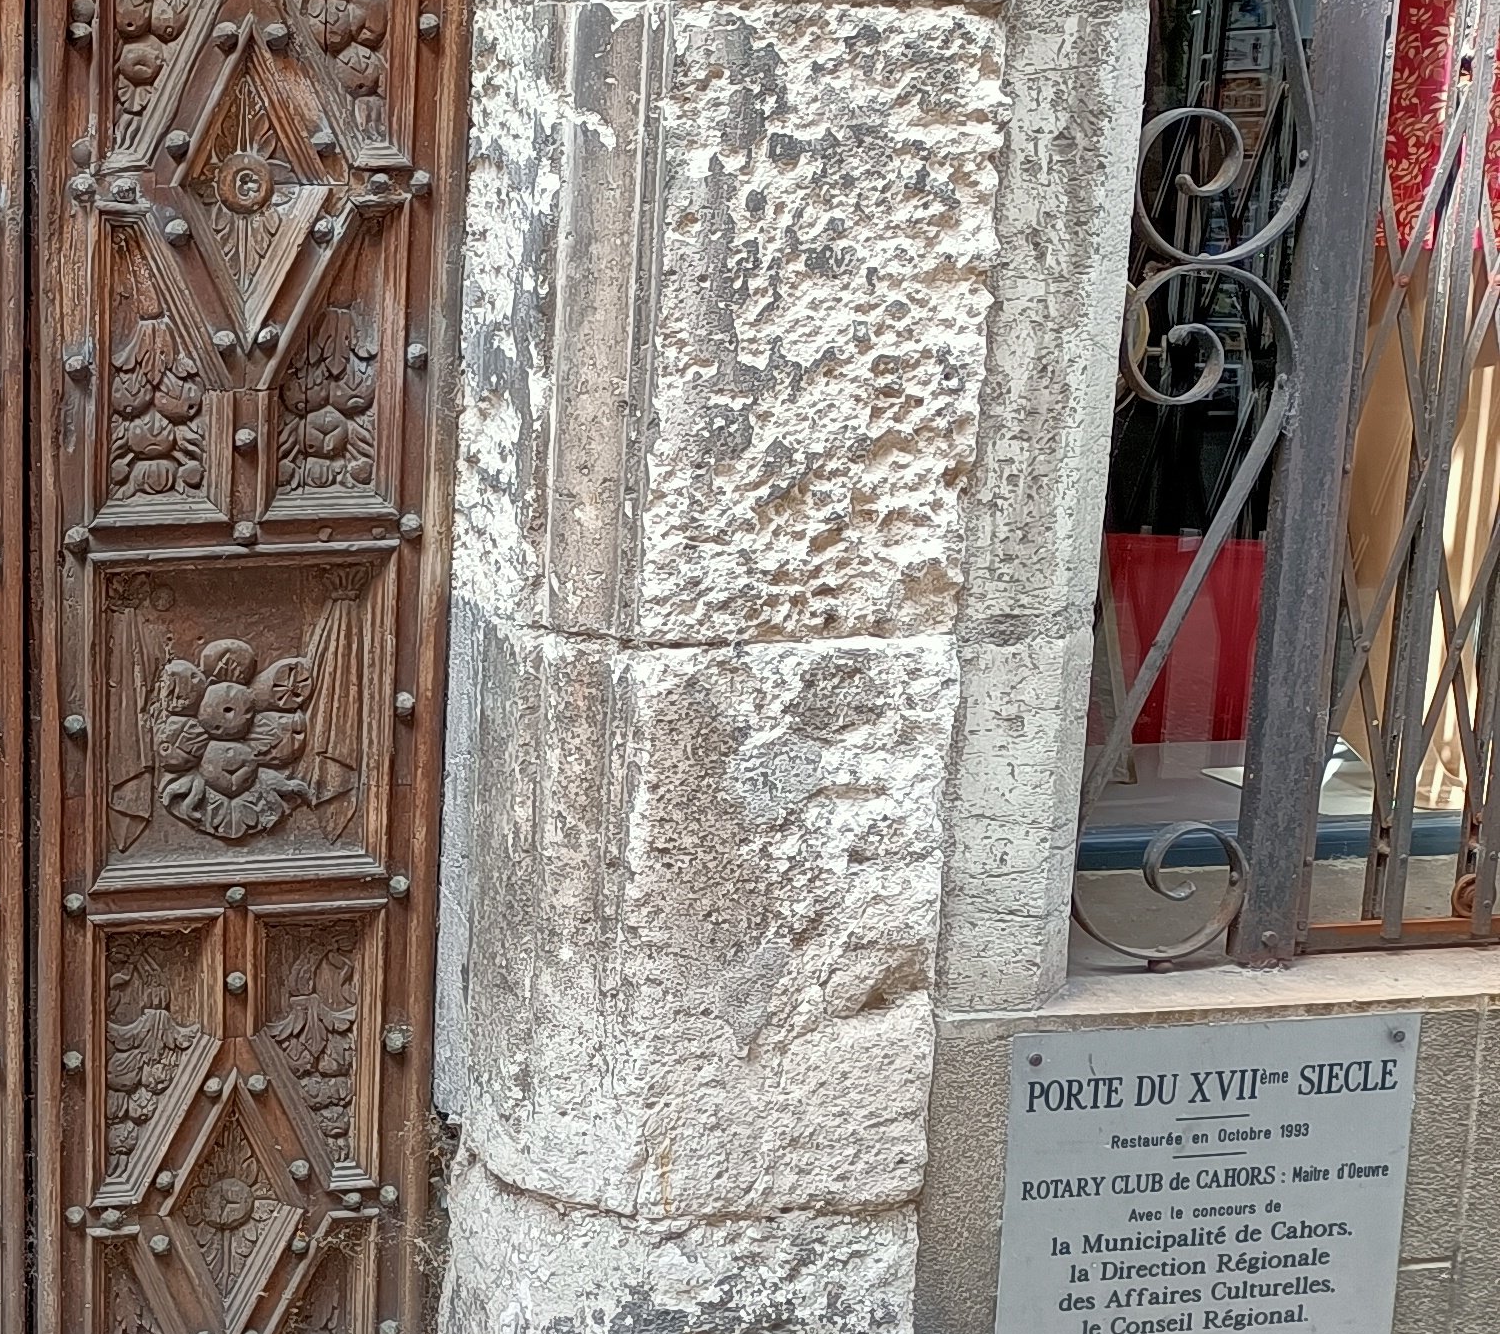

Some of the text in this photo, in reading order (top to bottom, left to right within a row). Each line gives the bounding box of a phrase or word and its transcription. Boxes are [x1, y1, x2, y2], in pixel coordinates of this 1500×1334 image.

[1026, 1077, 1124, 1113] PORTE
[1134, 1073, 1179, 1107] DU
[1298, 1059, 1398, 1096] SIECLE
[1111, 1123, 1309, 1149] Restaurée en Octobre 1993
[1021, 1176, 1106, 1201] ROTARY
[1111, 1173, 1163, 1195] CLUB
[1169, 1172, 1190, 1191] de
[1196, 1165, 1276, 1189] CAHORS
[1337, 1162, 1389, 1180] d'Oeuvre
[1128, 1199, 1281, 1222] Avec le concours de
[1051, 1237, 1072, 1256] la
[1081, 1225, 1226, 1254] Municipalité
[1235, 1224, 1262, 1243] de
[1069, 1247, 1330, 1283] la Direction Régionale
[1058, 1293, 1095, 1312] des
[1104, 1286, 1202, 1309] Affaires
[1202, 1304, 1308, 1331] Régional.
